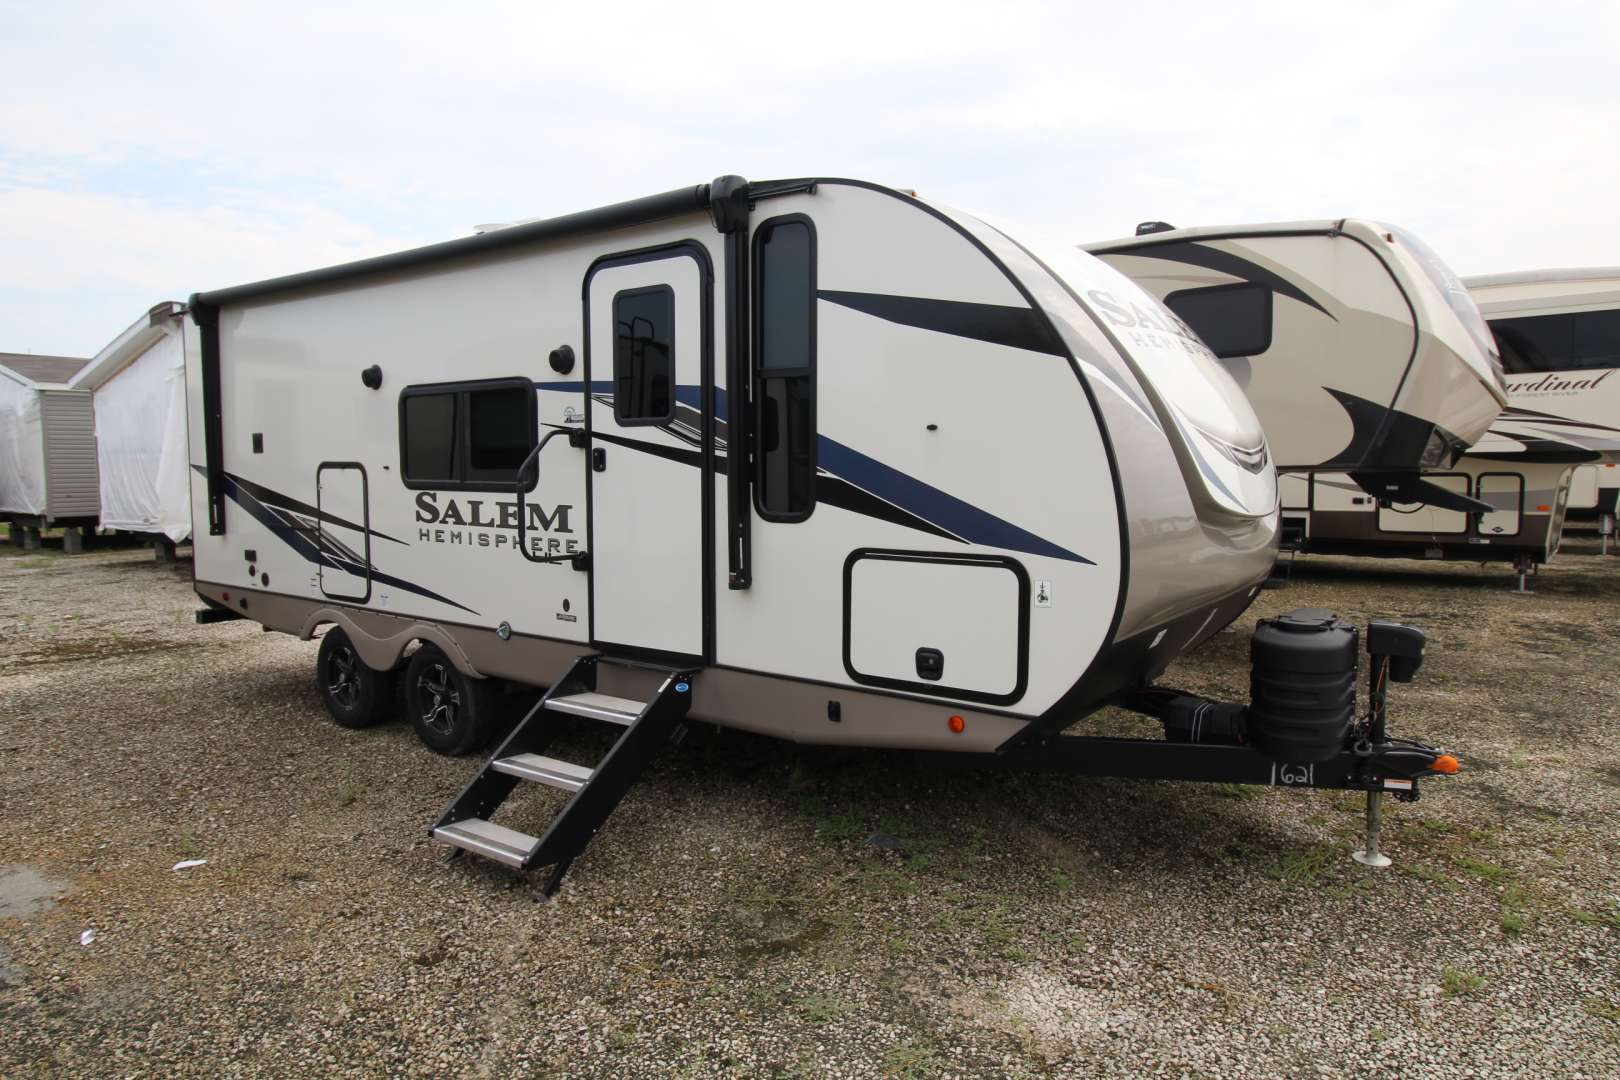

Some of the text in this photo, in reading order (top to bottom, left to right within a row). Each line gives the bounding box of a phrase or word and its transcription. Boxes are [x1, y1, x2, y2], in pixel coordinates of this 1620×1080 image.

[1506, 368, 1616, 392] ardinal
[415, 491, 574, 534] SALEM
[1270, 761, 1314, 786] 1621
